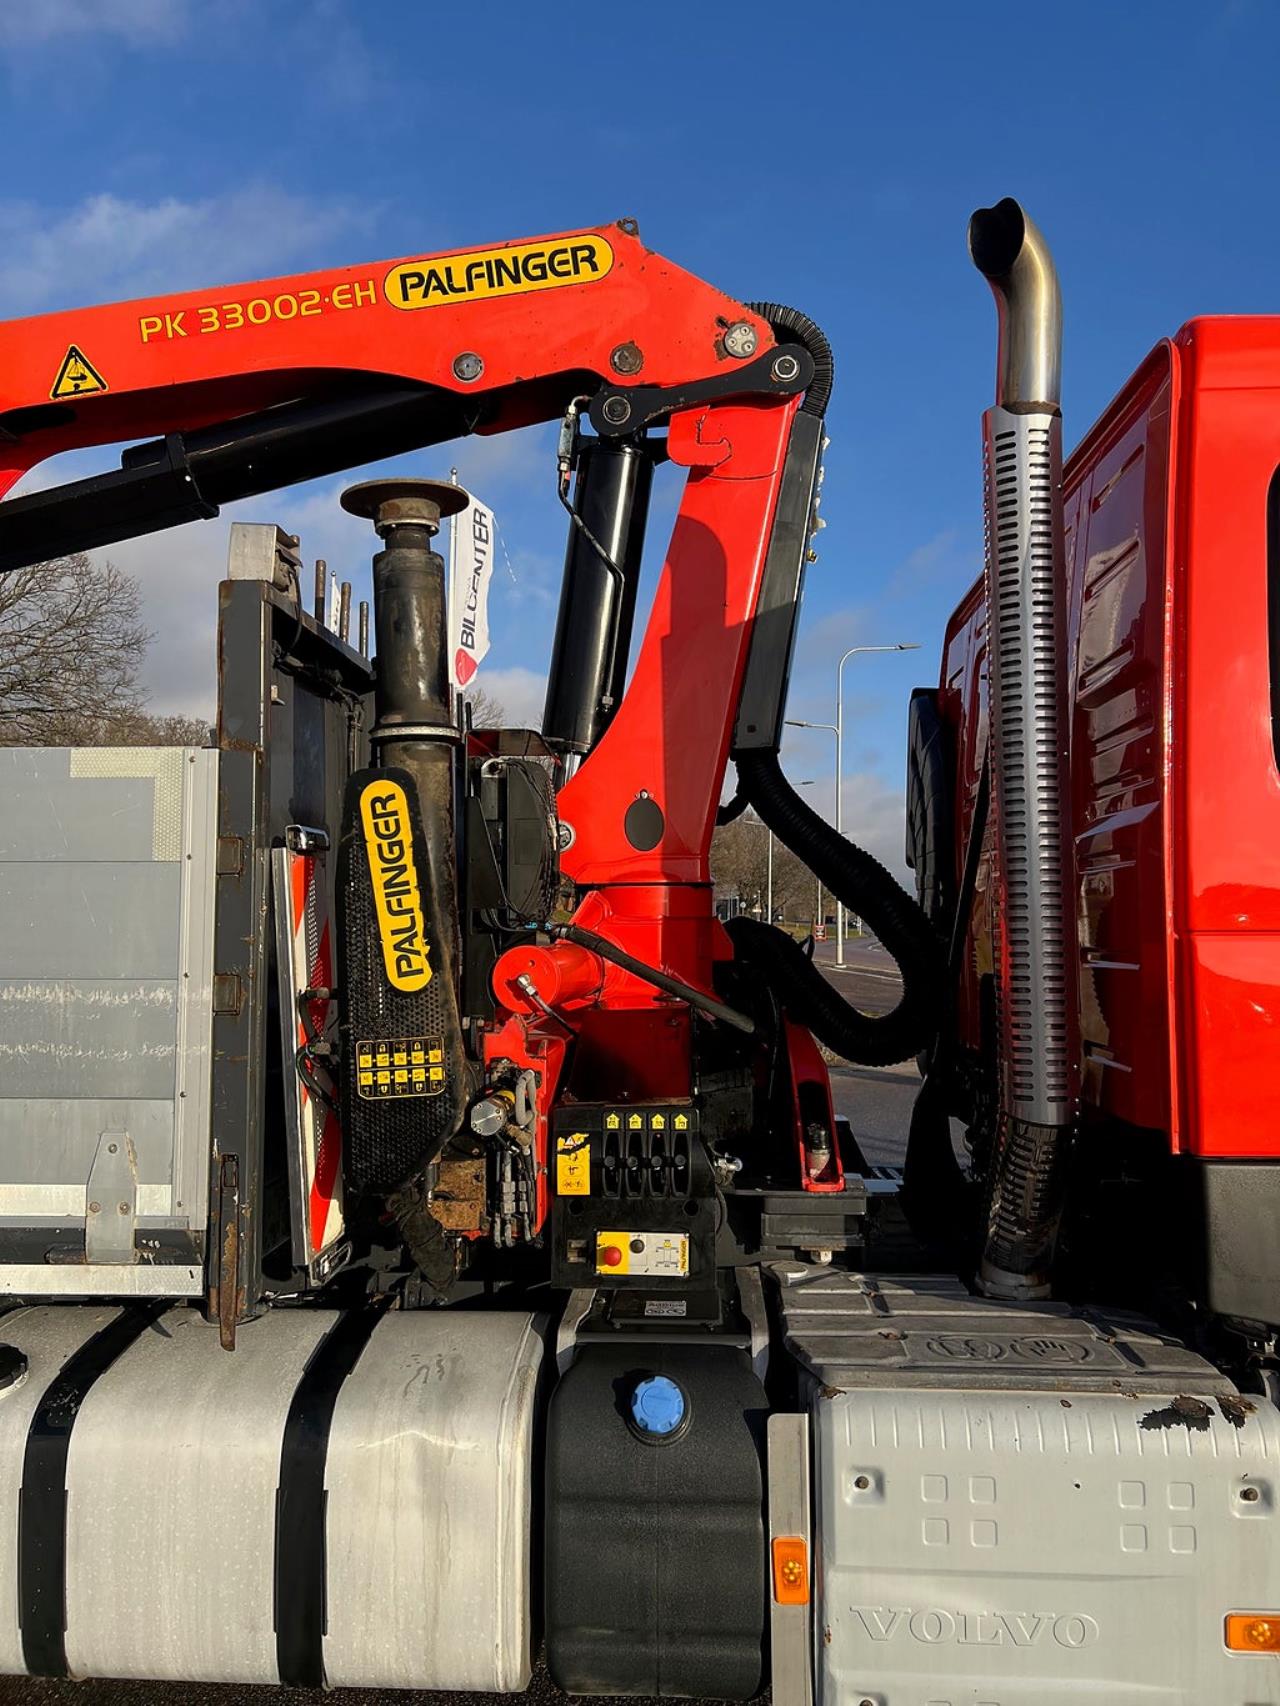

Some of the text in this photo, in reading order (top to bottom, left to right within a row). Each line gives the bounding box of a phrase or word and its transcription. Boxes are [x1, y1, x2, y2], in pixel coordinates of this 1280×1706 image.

[399, 244, 600, 302] PALFINGER
[139, 311, 188, 343] PK
[370, 793, 425, 979] PALFINGER
[850, 1605, 1100, 1649] VOLVO
